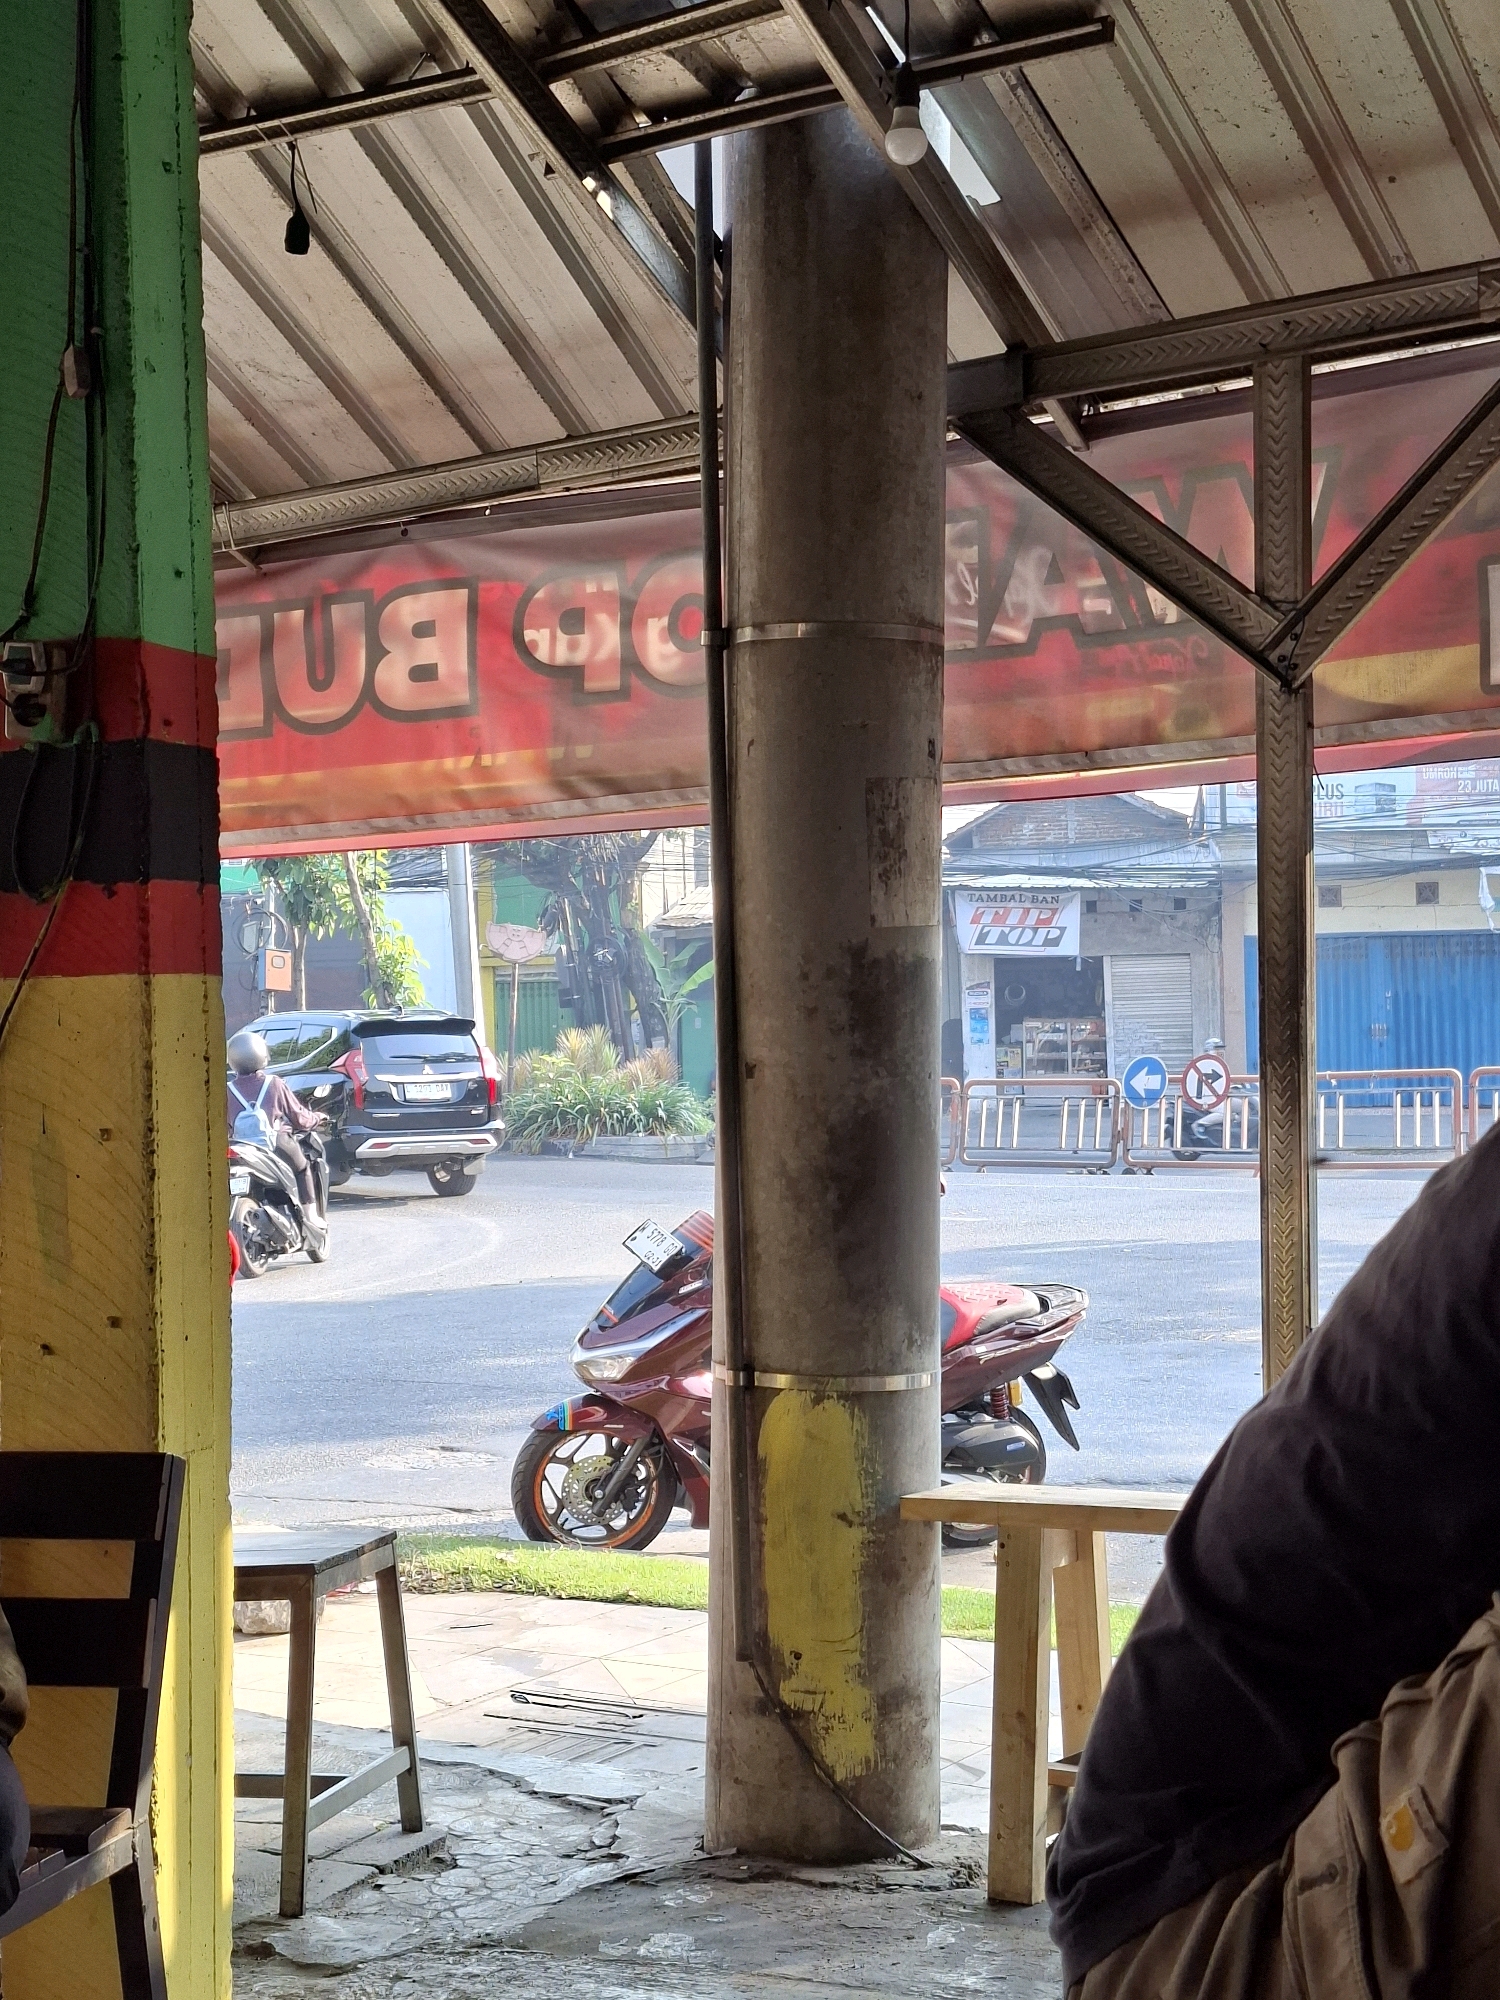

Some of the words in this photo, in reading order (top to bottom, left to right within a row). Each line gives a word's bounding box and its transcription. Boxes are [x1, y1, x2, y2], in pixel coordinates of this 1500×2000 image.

[1422, 766, 1457, 779] UMROH
[967, 893, 1026, 904] TAMBAL
[1030, 895, 1060, 905] BAN
[975, 907, 1054, 925] TIP
[981, 926, 1061, 946] TOP
[646, 1227, 667, 1248] 5778
